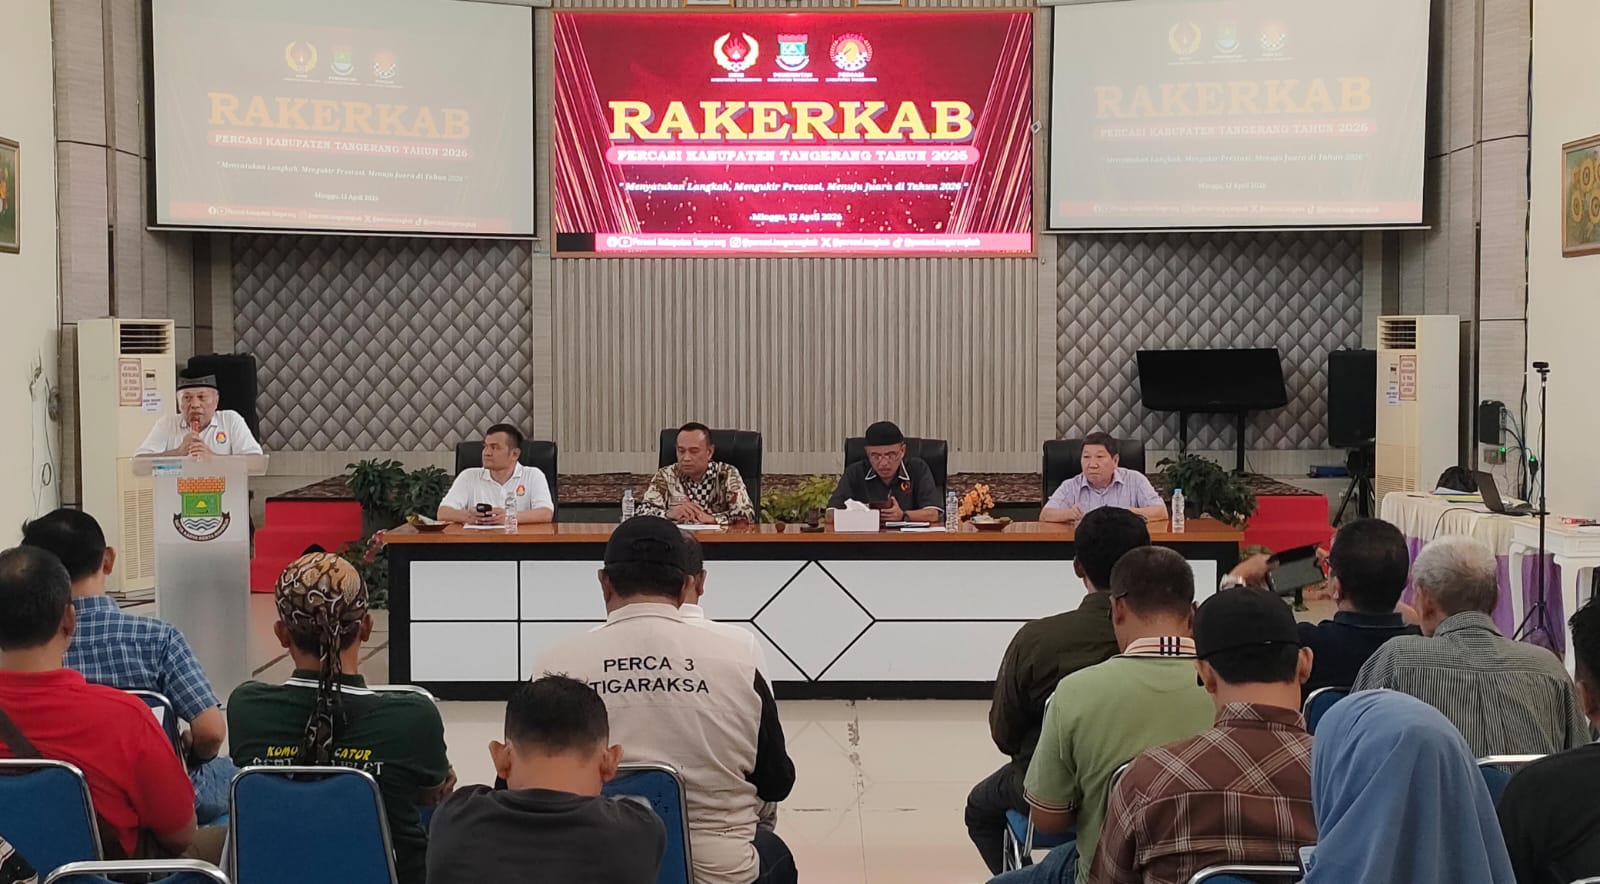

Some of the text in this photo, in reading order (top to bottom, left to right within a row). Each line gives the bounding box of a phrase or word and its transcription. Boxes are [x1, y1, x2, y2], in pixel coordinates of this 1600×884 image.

[1094, 76, 1371, 118] RAKERKAB
[208, 92, 471, 139] RAKERKAB
[608, 100, 975, 142] RAKERKAB
[1338, 122, 1369, 133] 2026
[215, 134, 468, 158] PERCASI KABUPATEN TANGERANG TAHUN 2026
[617, 150, 968, 161] PERCASI KABUPATEN TANGERANG TAHUN 2026
[625, 182, 685, 192] Menyatukan
[894, 182, 905, 191] di
[907, 182, 938, 191] Tahun
[939, 182, 961, 191] 2026
[603, 655, 695, 673] PERCA 3
[588, 677, 710, 694] TIGARAKSA
